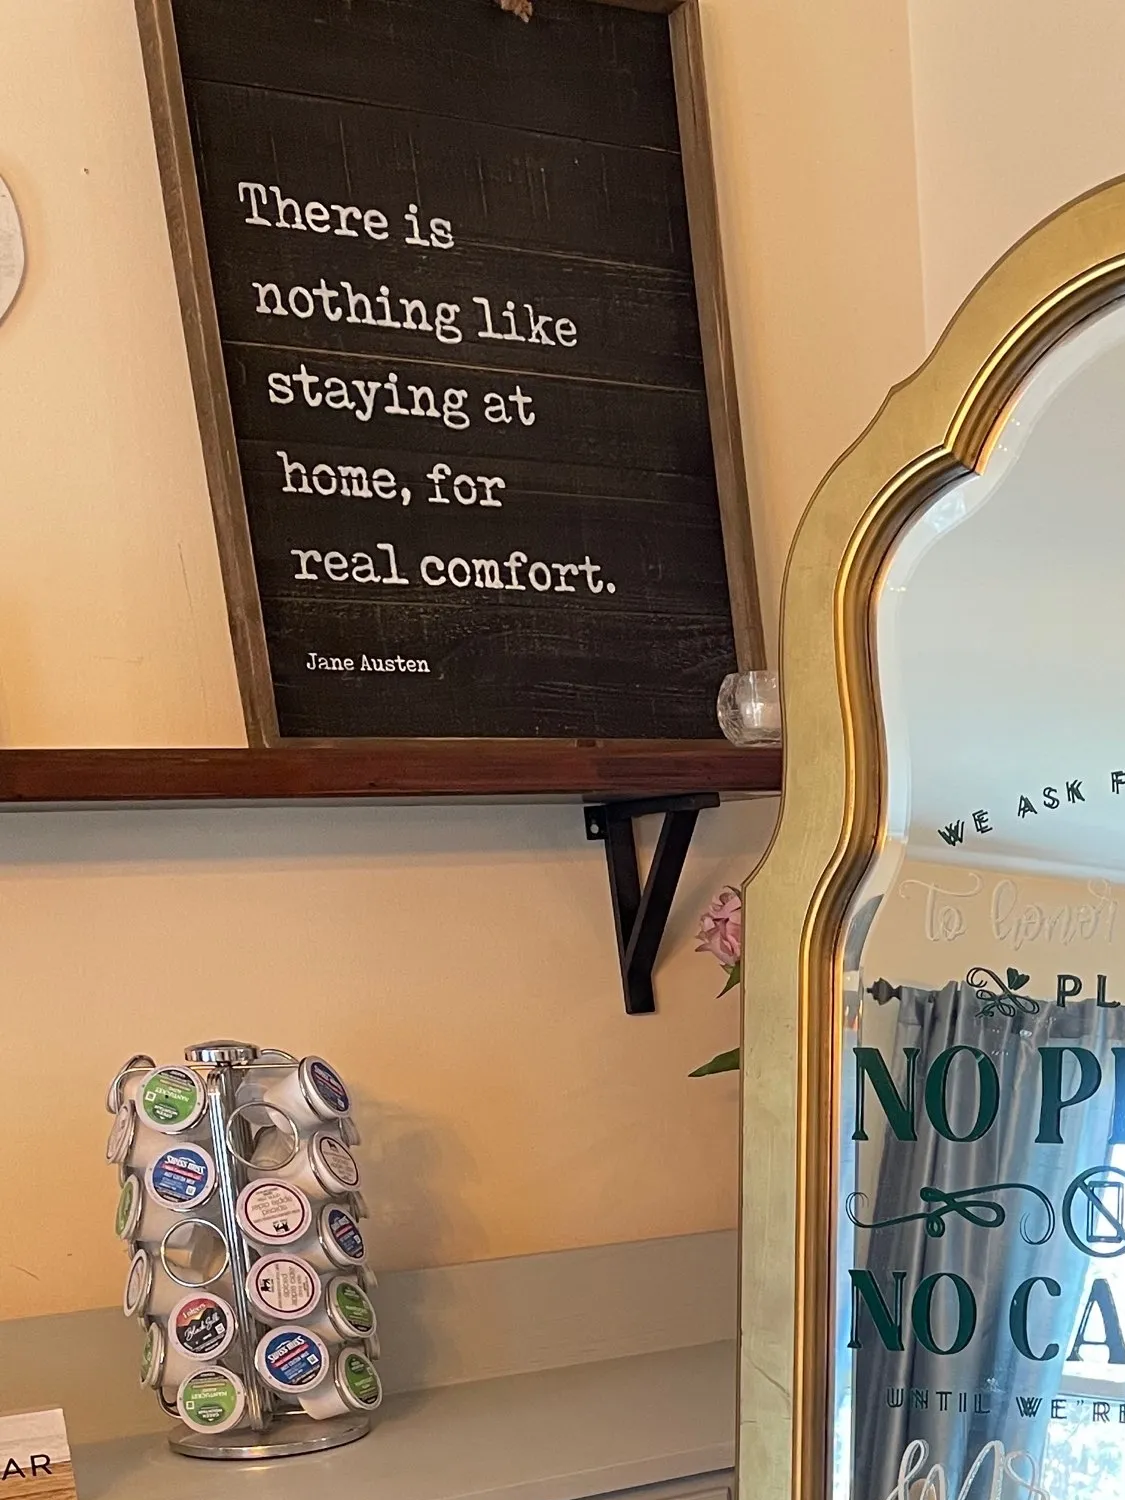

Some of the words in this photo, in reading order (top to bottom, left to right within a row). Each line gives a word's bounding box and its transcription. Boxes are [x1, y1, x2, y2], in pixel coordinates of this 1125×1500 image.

[238, 181, 389, 241] There
[404, 203, 455, 250] is
[252, 278, 462, 344] nothing
[473, 296, 578, 347] like
[268, 363, 469, 429] staying
[484, 385, 536, 426] at
[276, 450, 412, 506] home,
[426, 463, 506, 507] for
[291, 543, 409, 585] real
[420, 551, 616, 594] comfort.
[306, 652, 355, 673] Jane
[360, 654, 431, 674] Austen
[938, 810, 994, 847] WE
[1018, 779, 1086, 819] ASK
[851, 1045, 1000, 1144] NO
[847, 1268, 978, 1356] NO
[886, 1388, 991, 1414] UNTIL
